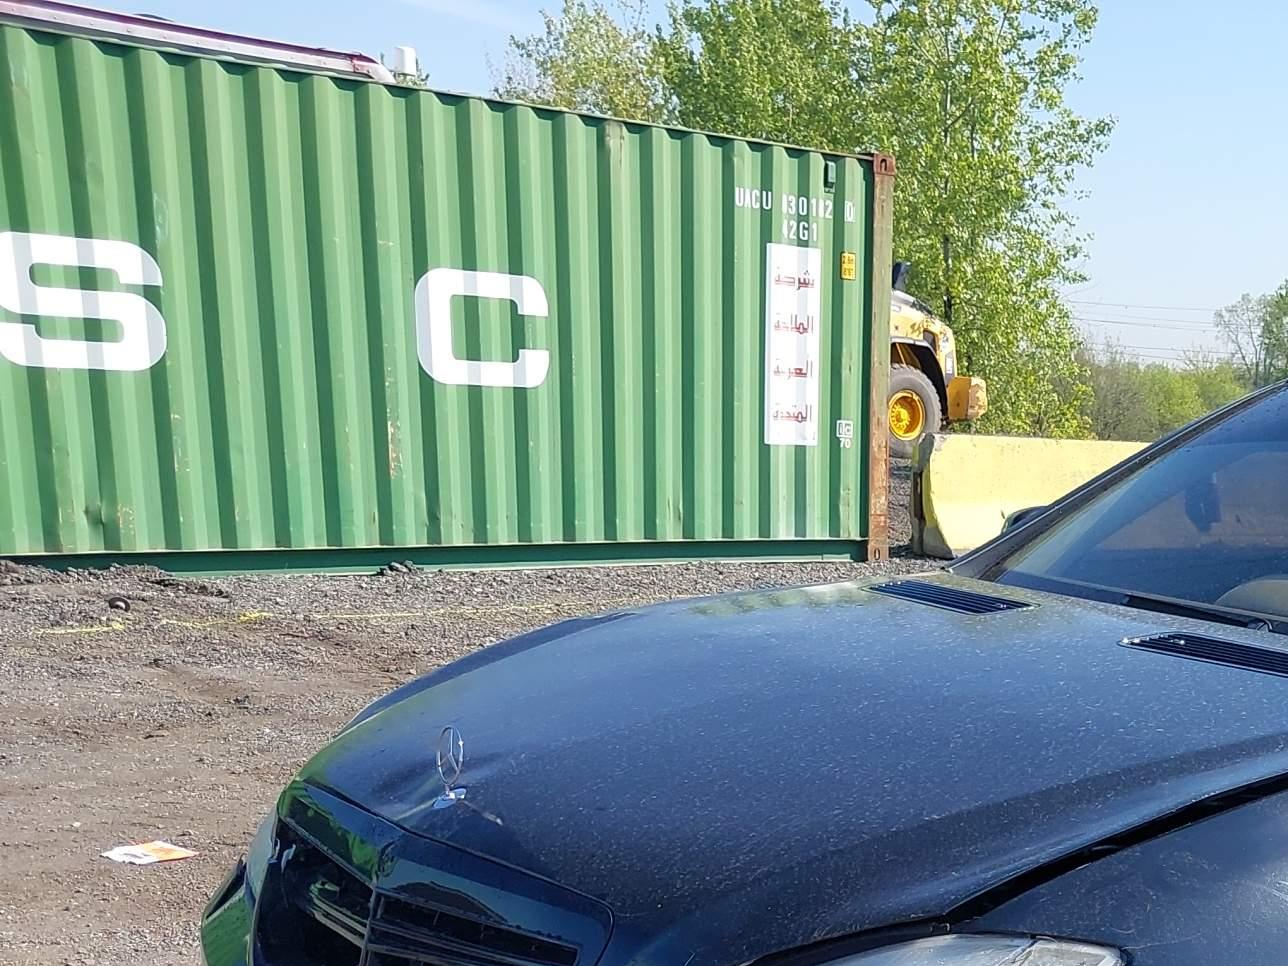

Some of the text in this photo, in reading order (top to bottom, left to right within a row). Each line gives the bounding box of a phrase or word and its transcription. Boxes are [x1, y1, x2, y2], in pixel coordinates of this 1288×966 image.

[735, 186, 772, 210] UACU
[0, 231, 549, 388] S C
